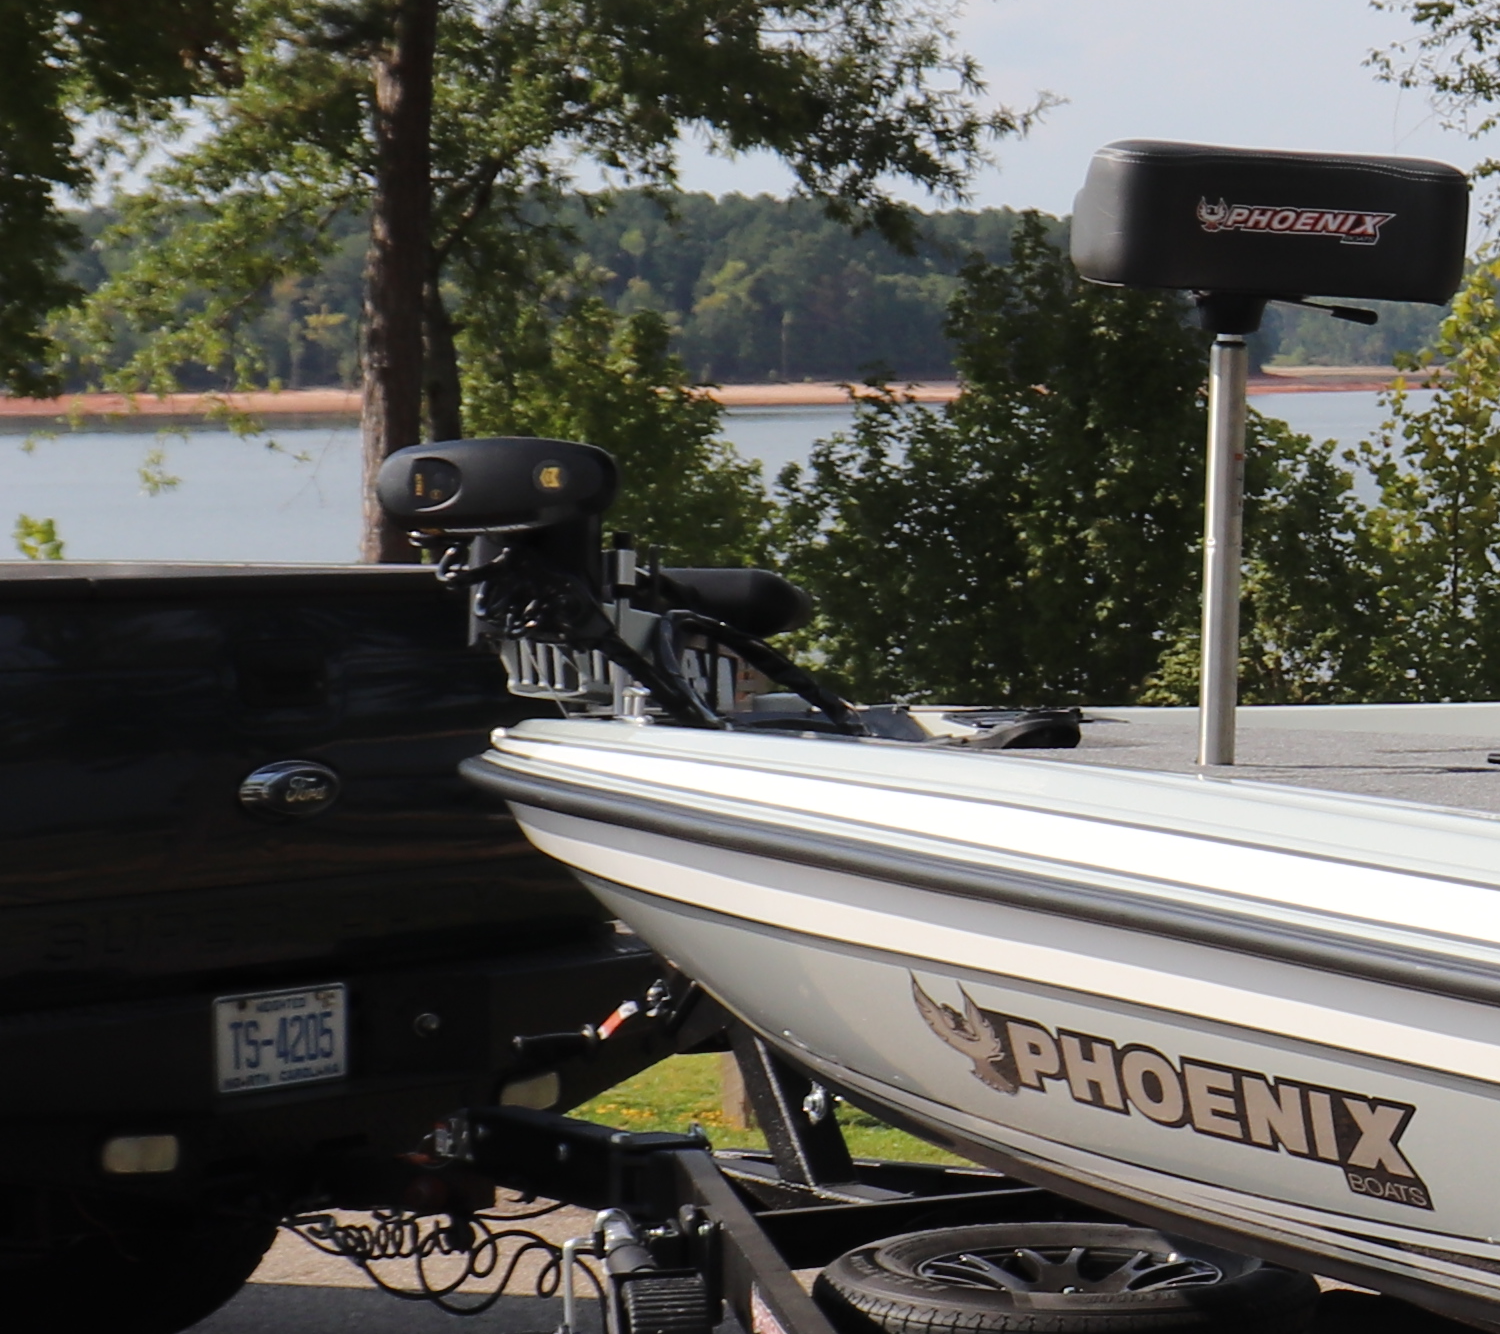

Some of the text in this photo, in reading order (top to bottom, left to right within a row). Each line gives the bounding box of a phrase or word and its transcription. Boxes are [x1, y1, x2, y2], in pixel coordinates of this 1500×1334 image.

[1223, 206, 1387, 236] PHOENIX
[285, 775, 328, 803] Ford
[228, 1010, 334, 1071] TS-4205
[1006, 1020, 1416, 1179] PHOENIX
[1348, 1172, 1427, 1208] BOATS
